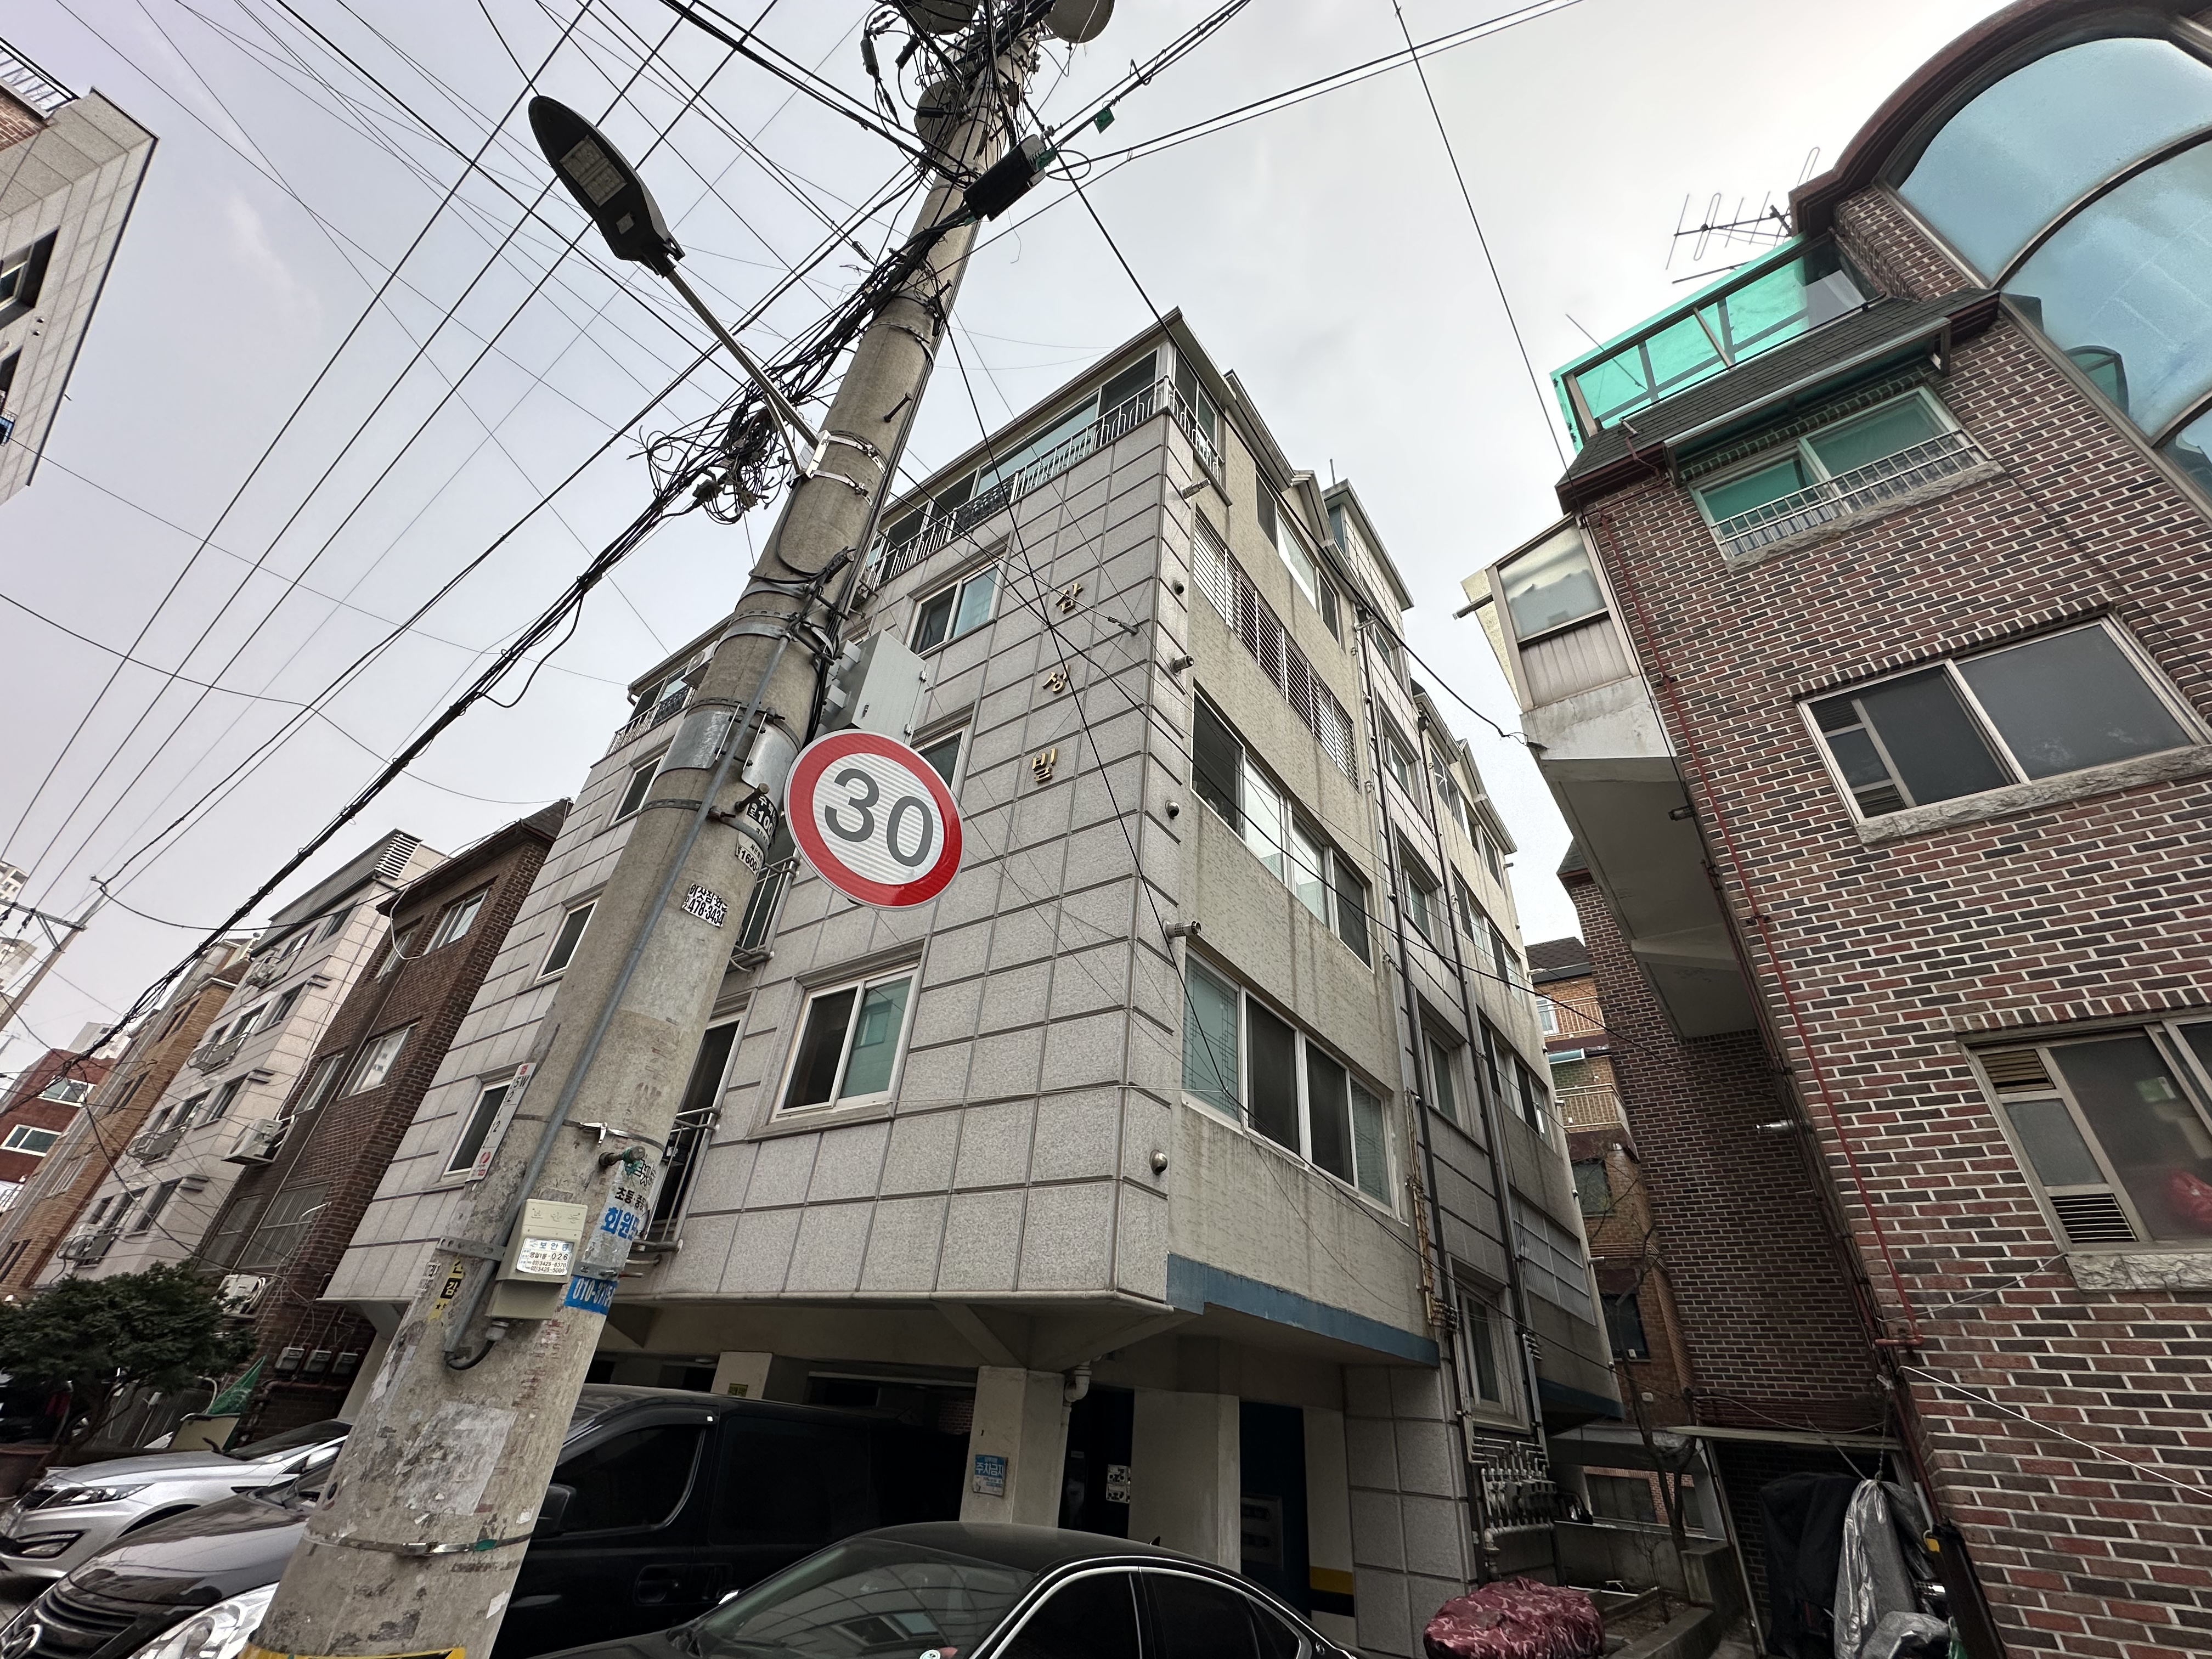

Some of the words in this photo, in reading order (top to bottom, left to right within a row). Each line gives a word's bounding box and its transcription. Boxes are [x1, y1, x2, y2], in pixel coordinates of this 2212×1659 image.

[824, 768, 934, 868] 30
[688, 899, 725, 926] 478-3434
[975, 1462, 1004, 1476] 주차금지
